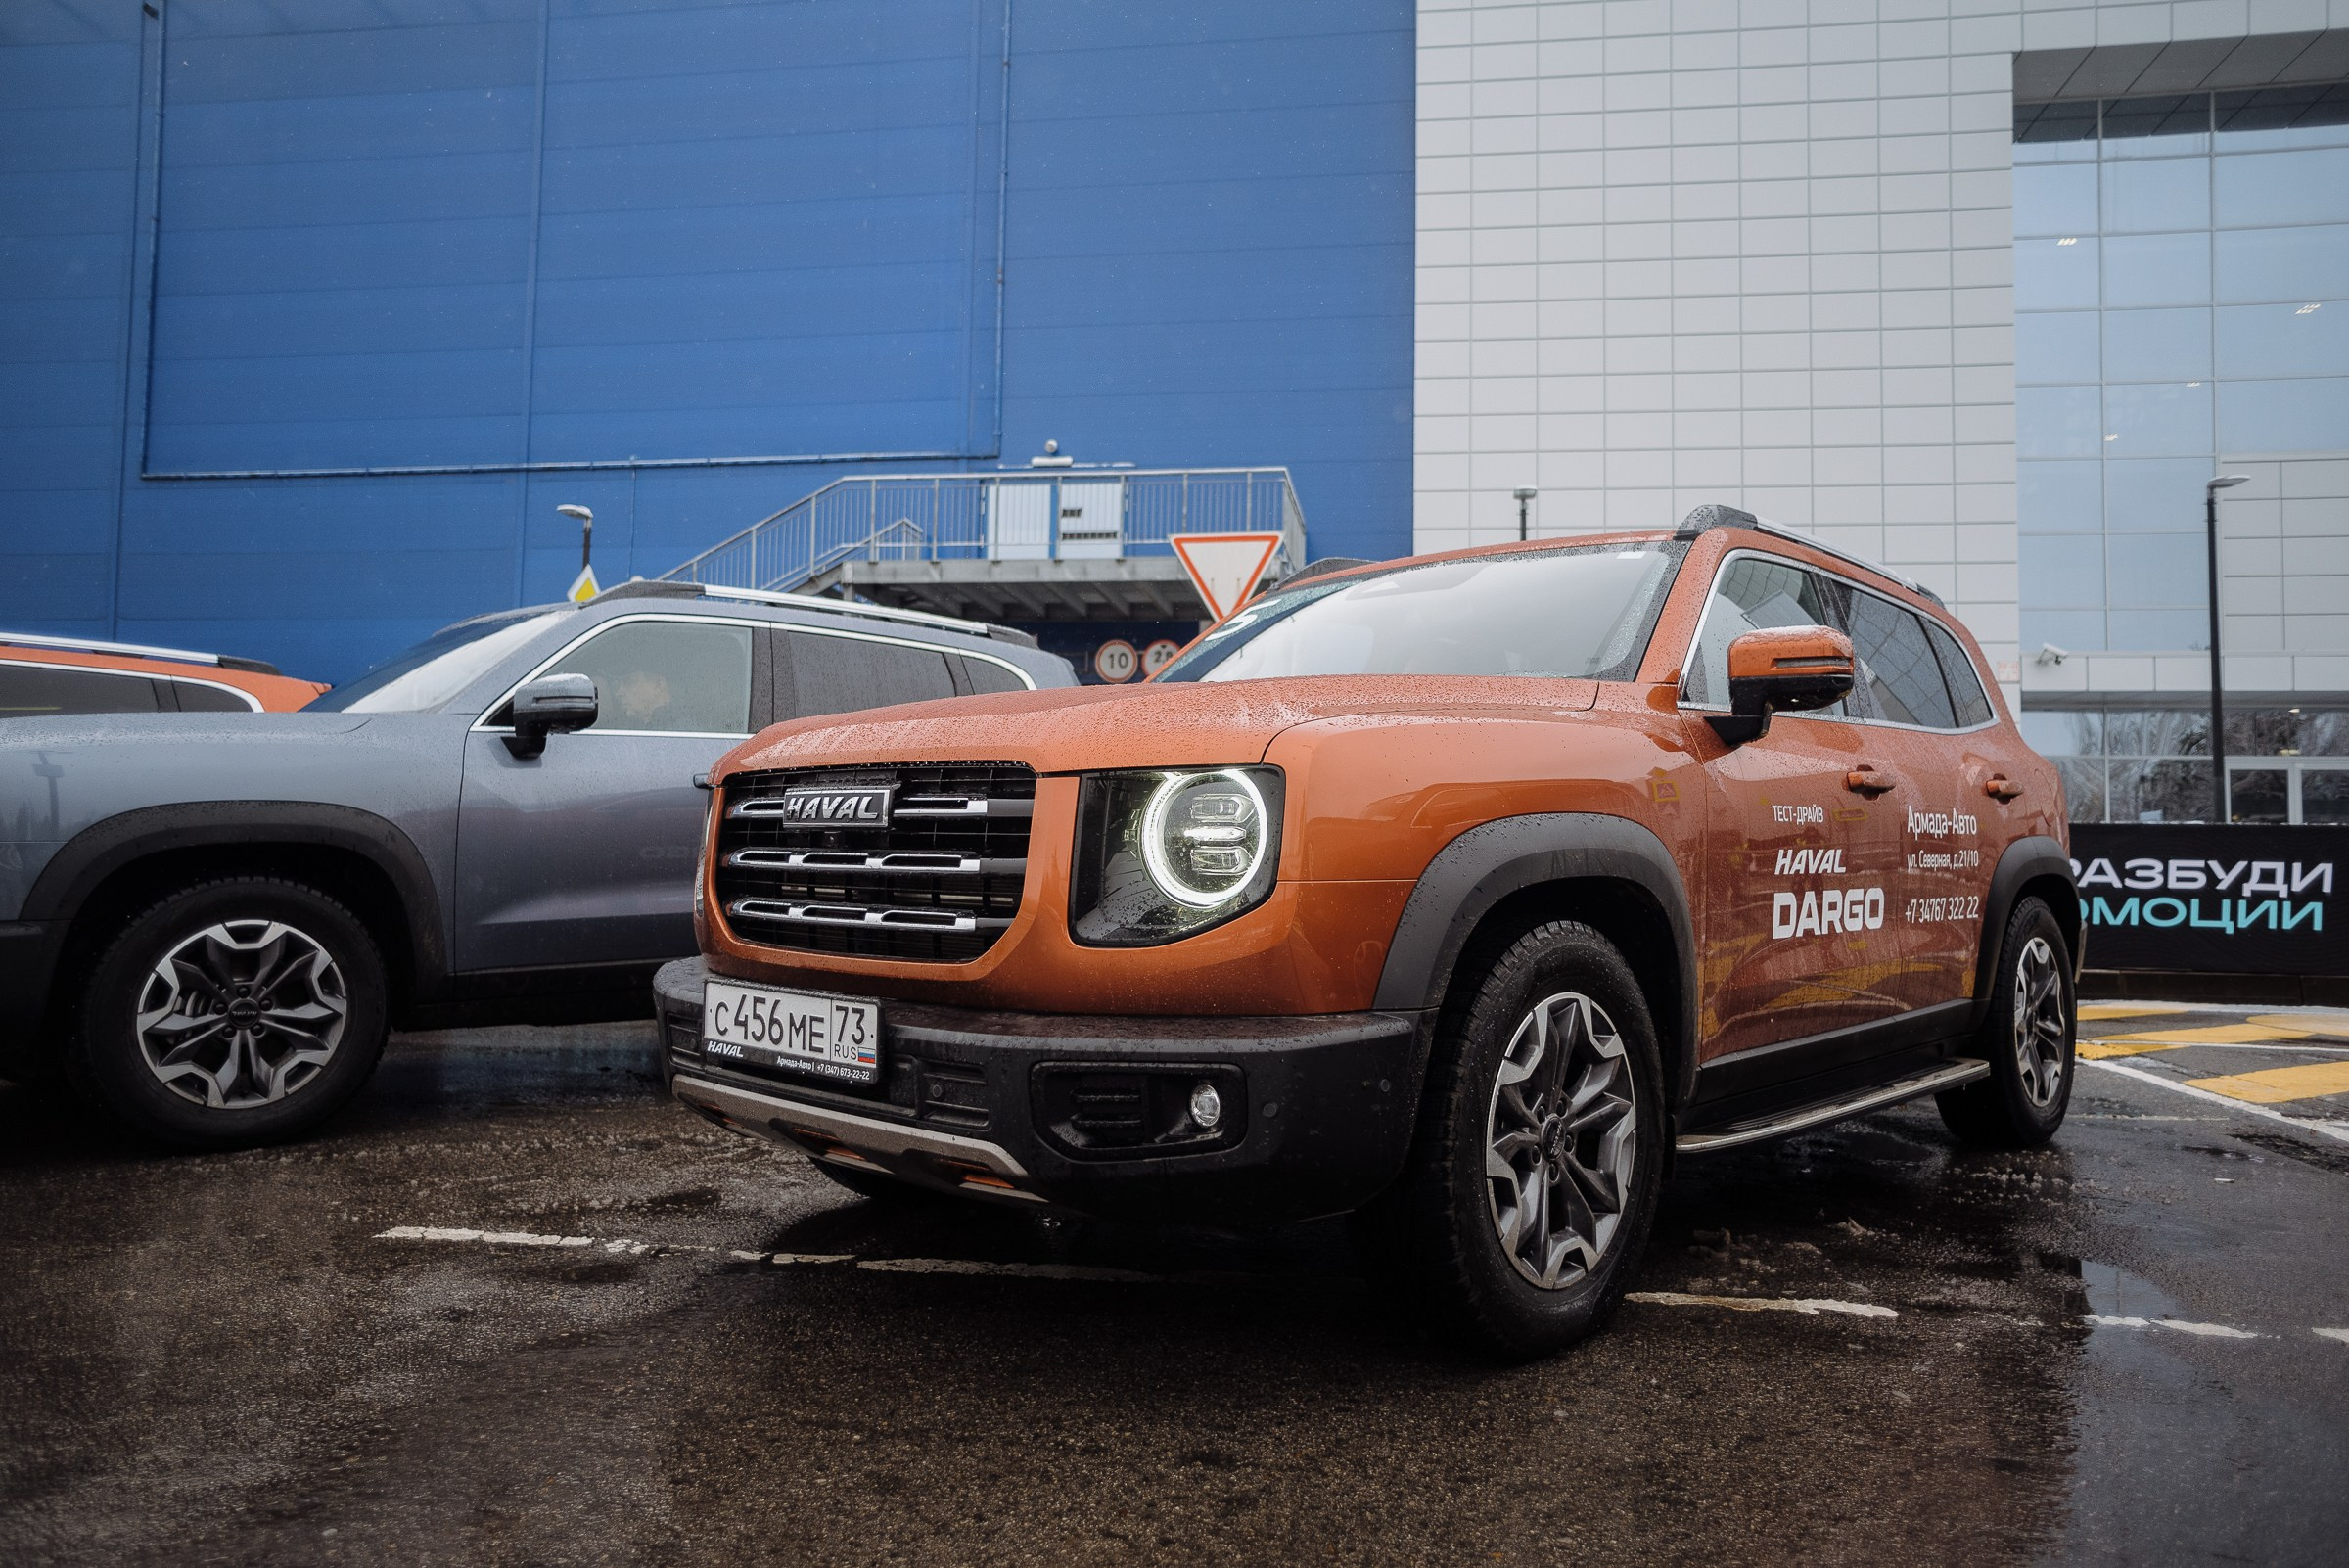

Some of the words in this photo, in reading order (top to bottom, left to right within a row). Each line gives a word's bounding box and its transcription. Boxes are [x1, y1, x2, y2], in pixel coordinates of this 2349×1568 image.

[1109, 652, 1128, 669] 10
[786, 796, 879, 821] HAVAL
[1772, 803, 1824, 825] ТЕСТ-ДРАЙВ
[1907, 805, 1977, 840] Армада-Авто
[1774, 849, 1847, 875] HAVAL
[1772, 887, 1885, 940] DARGO
[1905, 899, 1917, 924] +7
[1918, 898, 1947, 924] 34767
[1948, 897, 1965, 920] 322
[1966, 896, 1979, 919] 22
[2080, 896, 2323, 934] МОЦИИ
[835, 1005, 865, 1045] 73
[707, 1040, 744, 1058] HAVAL
[834, 1043, 857, 1060] RUS
